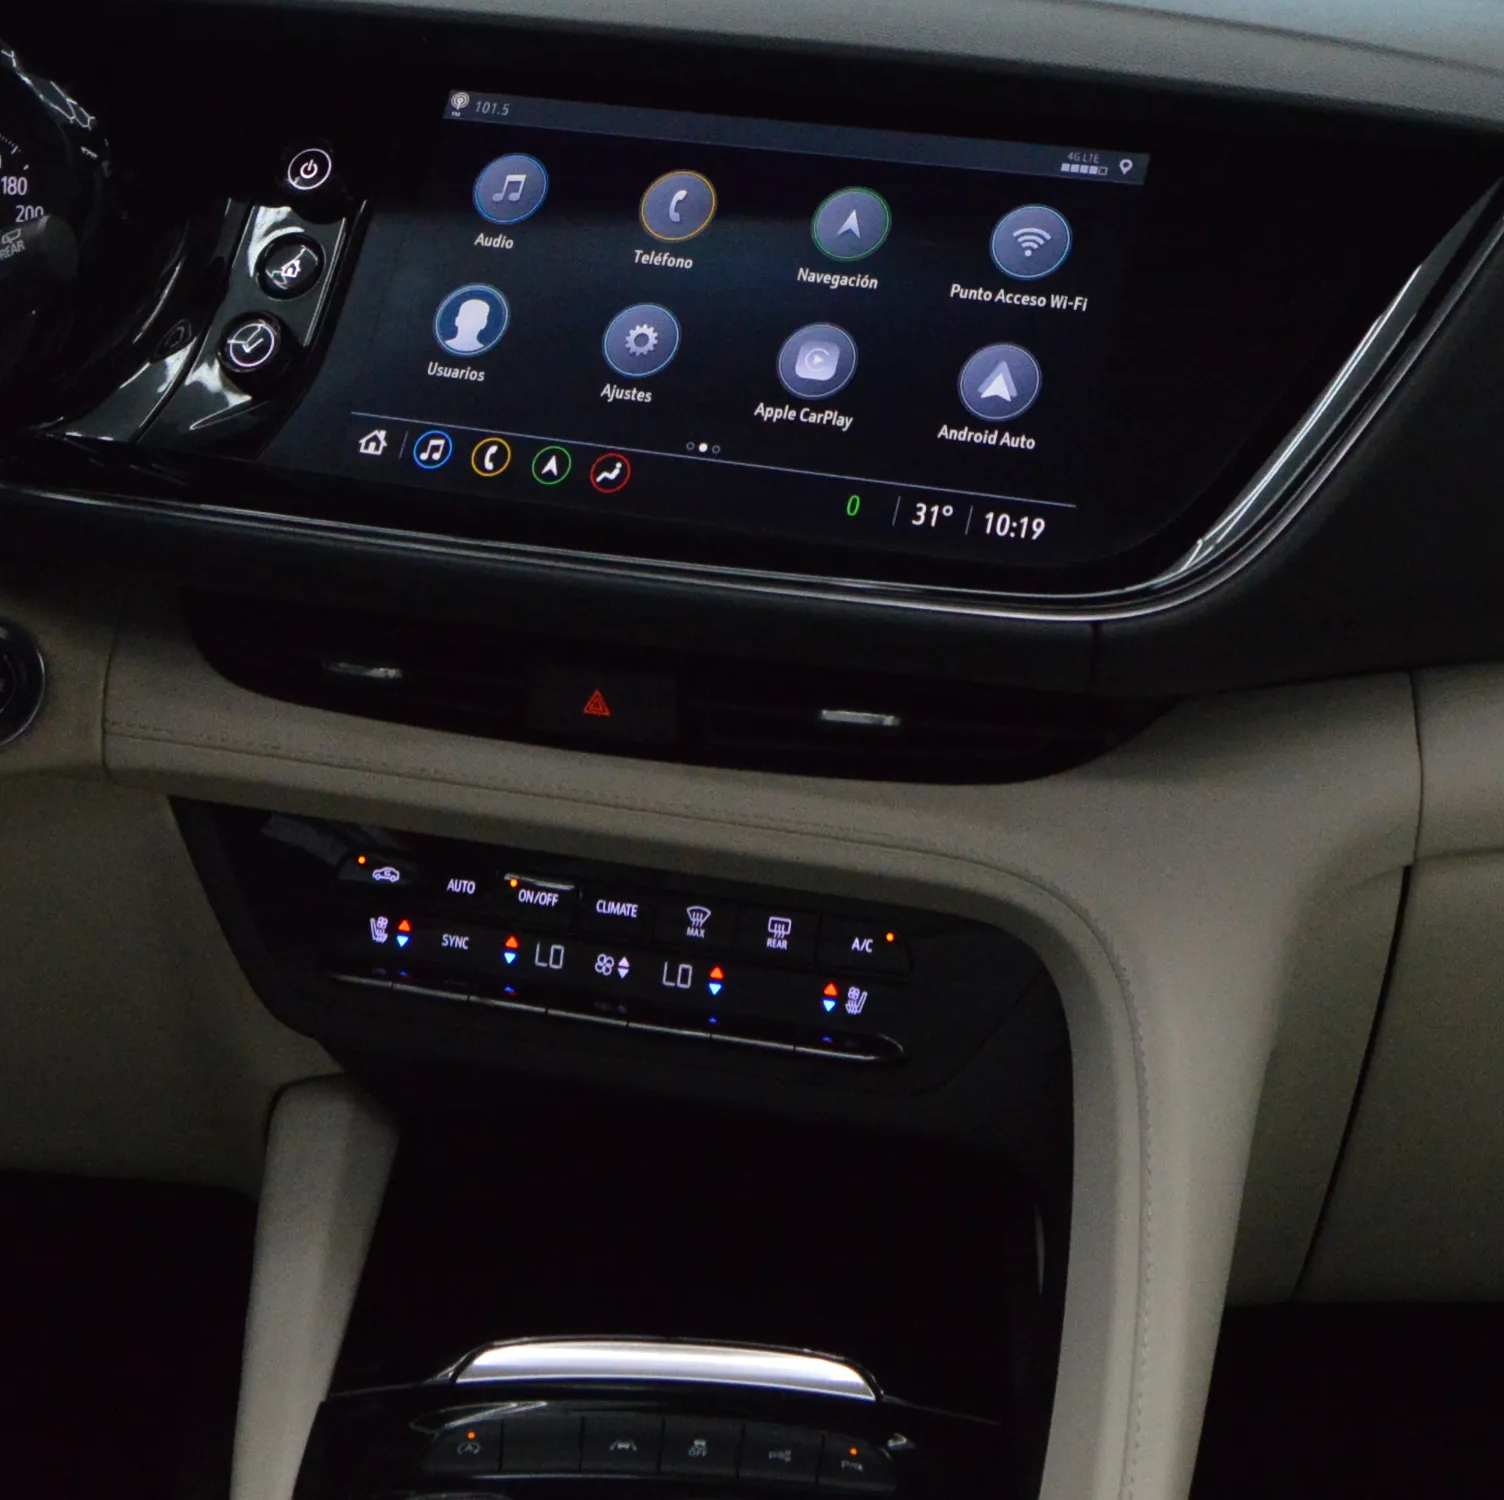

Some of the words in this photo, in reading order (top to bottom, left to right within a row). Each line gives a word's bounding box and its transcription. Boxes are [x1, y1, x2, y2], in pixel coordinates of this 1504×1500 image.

[475, 100, 510, 116] 101.5
[1067, 151, 1081, 162] 4G
[1082, 153, 1101, 164] LTE
[0, 175, 28, 196] 180
[15, 204, 45, 223] 200
[474, 232, 514, 250] Audio
[634, 249, 694, 269] Teléfono
[797, 267, 879, 290] Navegación
[949, 283, 994, 303] Punto
[995, 288, 1047, 308] Acceso
[1050, 293, 1088, 312] Wi-Fi
[427, 361, 486, 382] Usuarios
[599, 383, 653, 403] Ajustes
[753, 402, 796, 423] Apple
[799, 407, 854, 431] CarPlay
[937, 424, 998, 446] Android
[1000, 431, 1036, 450] Auto
[846, 494, 861, 517] 0
[911, 502, 954, 527] 31°
[984, 511, 1046, 540] 10:19
[446, 878, 476, 895] AUTO
[518, 889, 559, 908] ON/OFF
[596, 899, 639, 918] CLIMATE
[441, 934, 470, 950] SYNC
[686, 927, 705, 939] MAX
[766, 938, 788, 950] REAR
[851, 937, 874, 953] A/C
[534, 942, 565, 970] LO
[662, 961, 693, 989] LO
